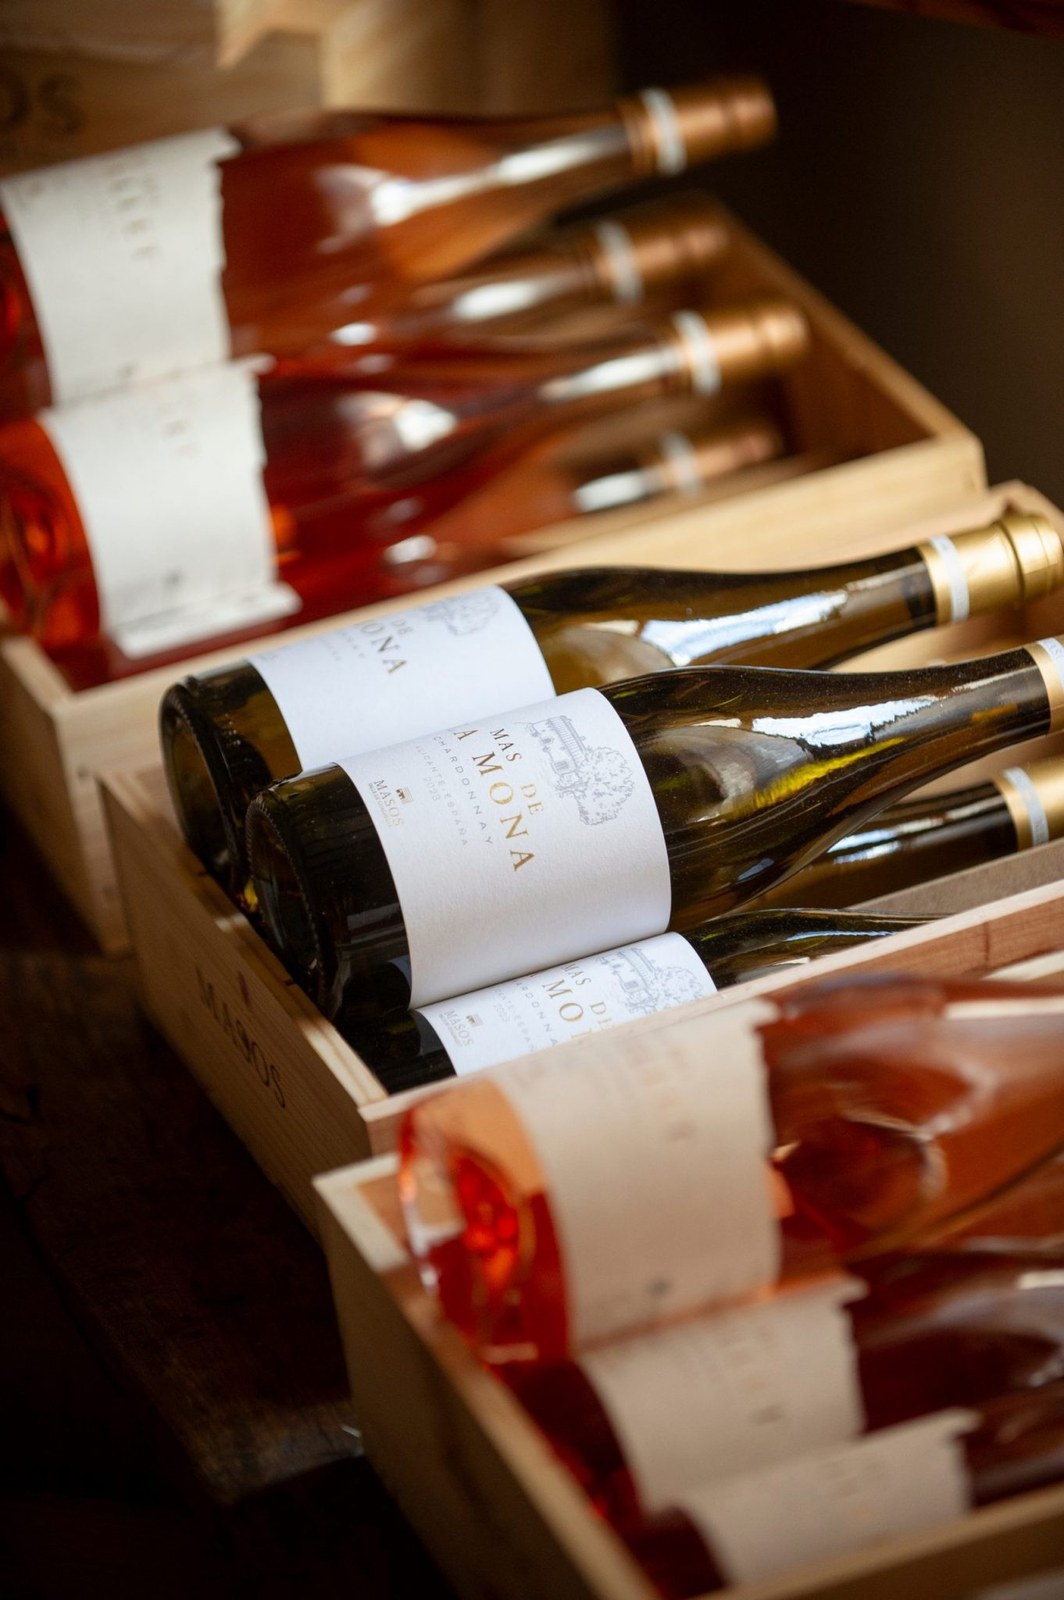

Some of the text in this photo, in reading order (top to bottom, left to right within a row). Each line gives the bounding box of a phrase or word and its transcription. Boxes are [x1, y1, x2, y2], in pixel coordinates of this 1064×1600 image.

[374, 779, 405, 827] MASOS
[433, 735, 493, 844] CHARDONNAY
[472, 751, 535, 872] MONA
[489, 728, 544, 816] MAS DE
